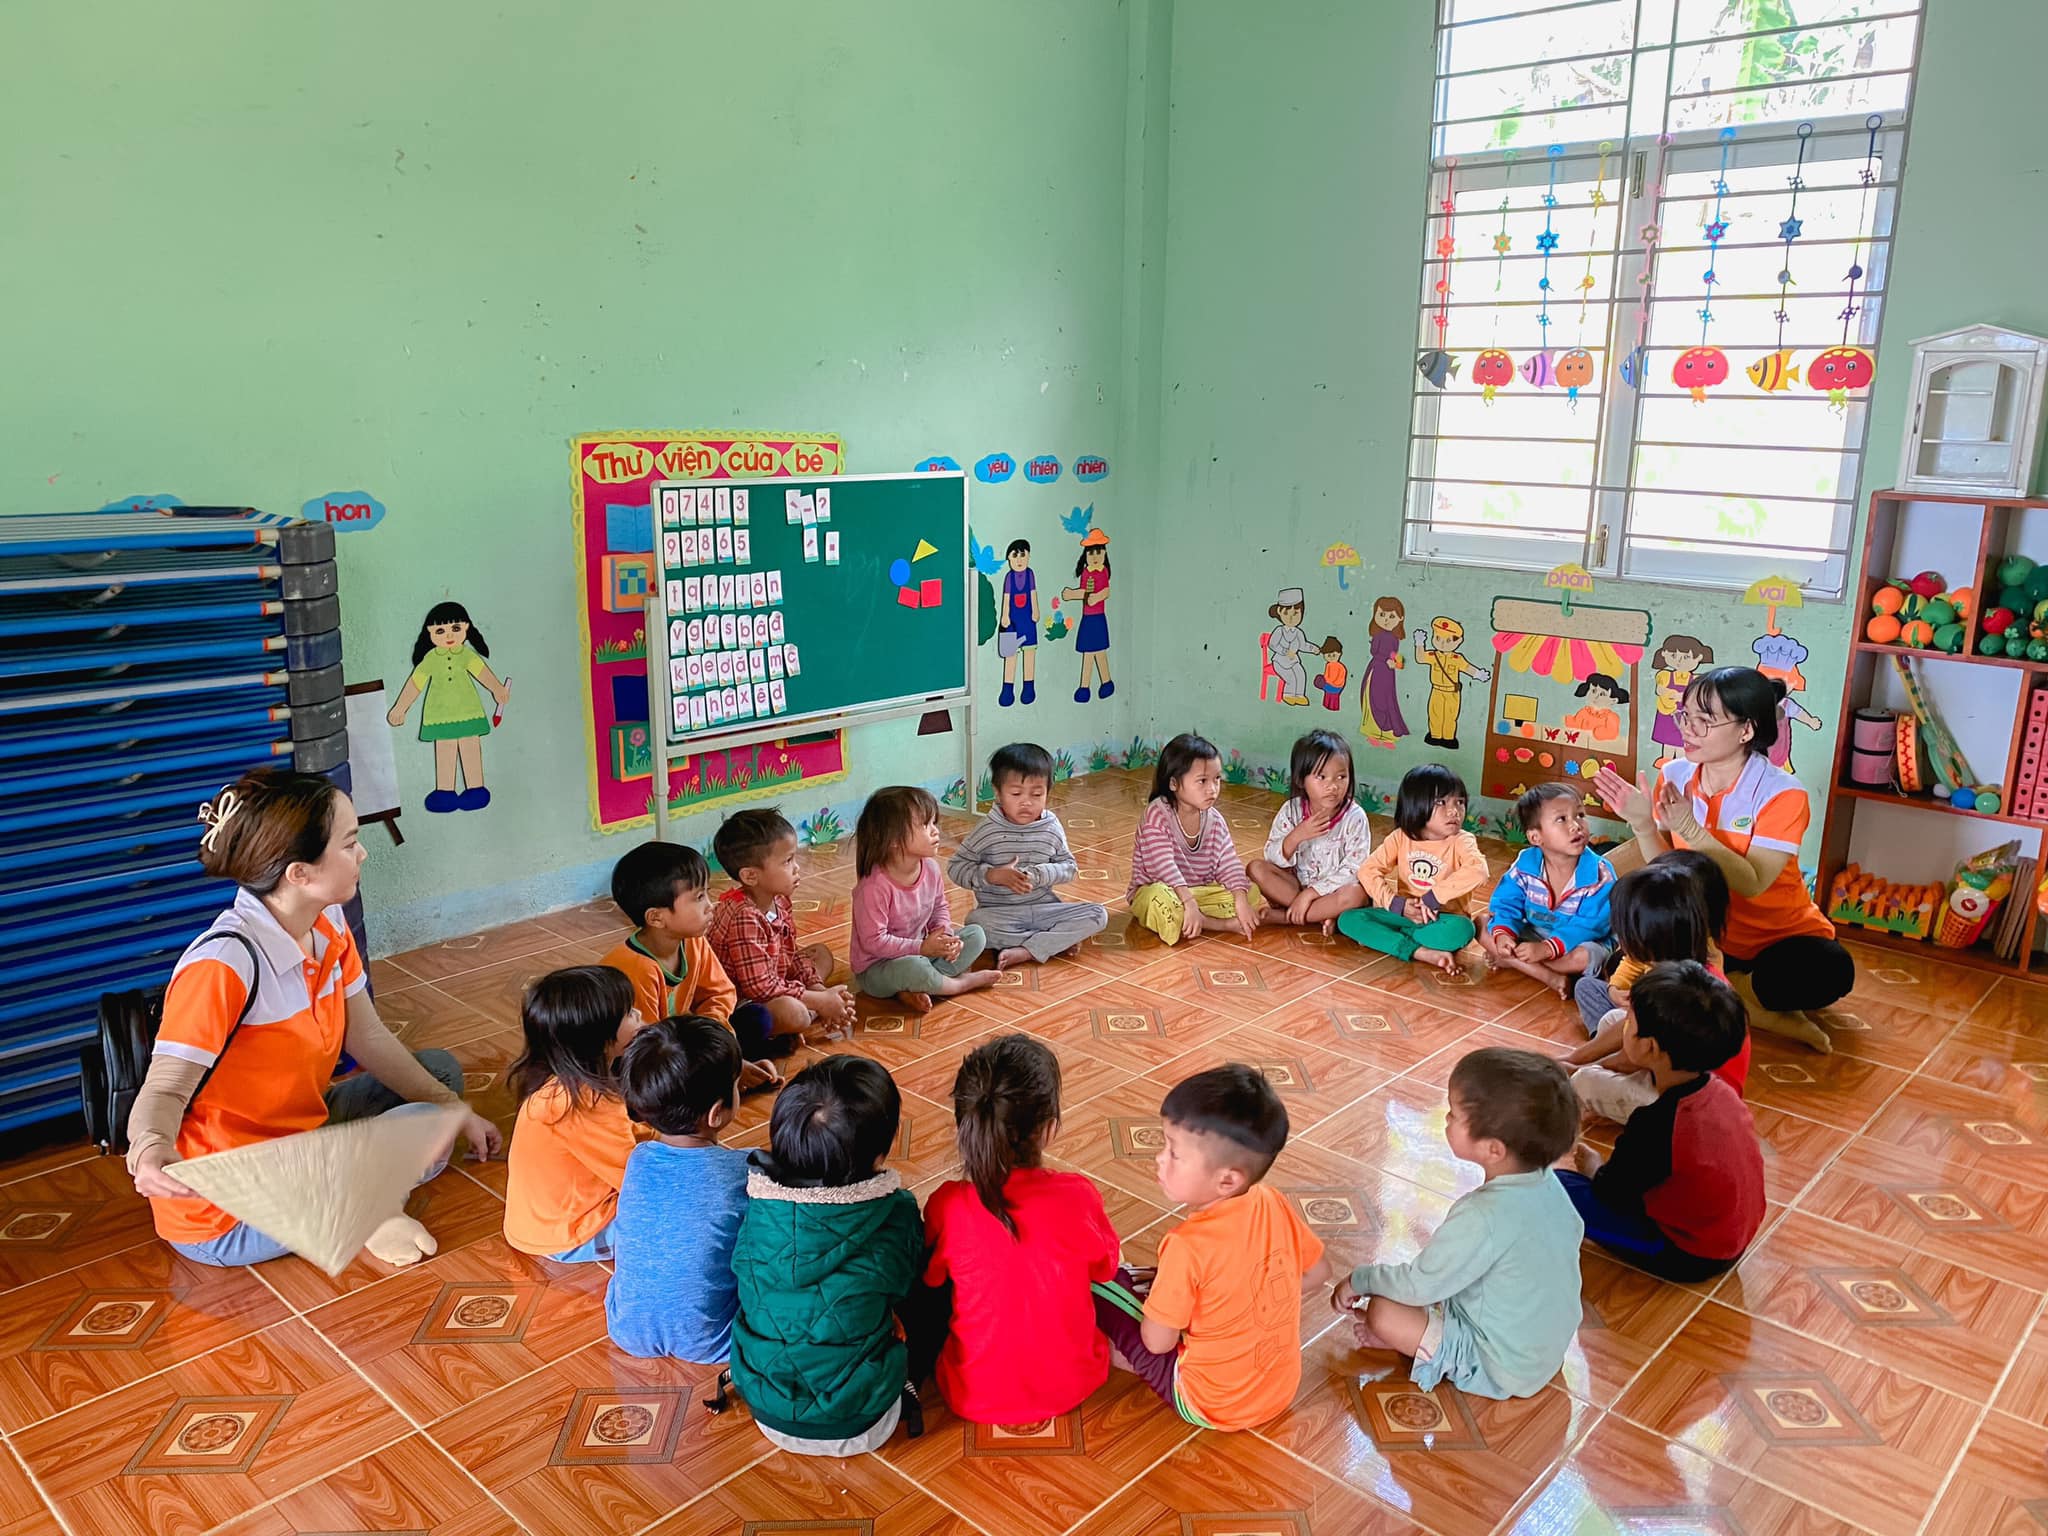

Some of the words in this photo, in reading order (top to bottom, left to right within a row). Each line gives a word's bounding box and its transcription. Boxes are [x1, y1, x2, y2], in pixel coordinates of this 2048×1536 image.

[592, 450, 643, 480] Thư
[662, 447, 712, 476] viện
[728, 443, 774, 472] của
[795, 448, 824, 472] bé
[987, 459, 1009, 478] yêu
[1030, 460, 1058, 477] thiên
[1077, 460, 1106, 475] nhiên
[324, 501, 371, 522] hon
[1326, 543, 1355, 566] góc
[1759, 585, 1787, 601] vai
